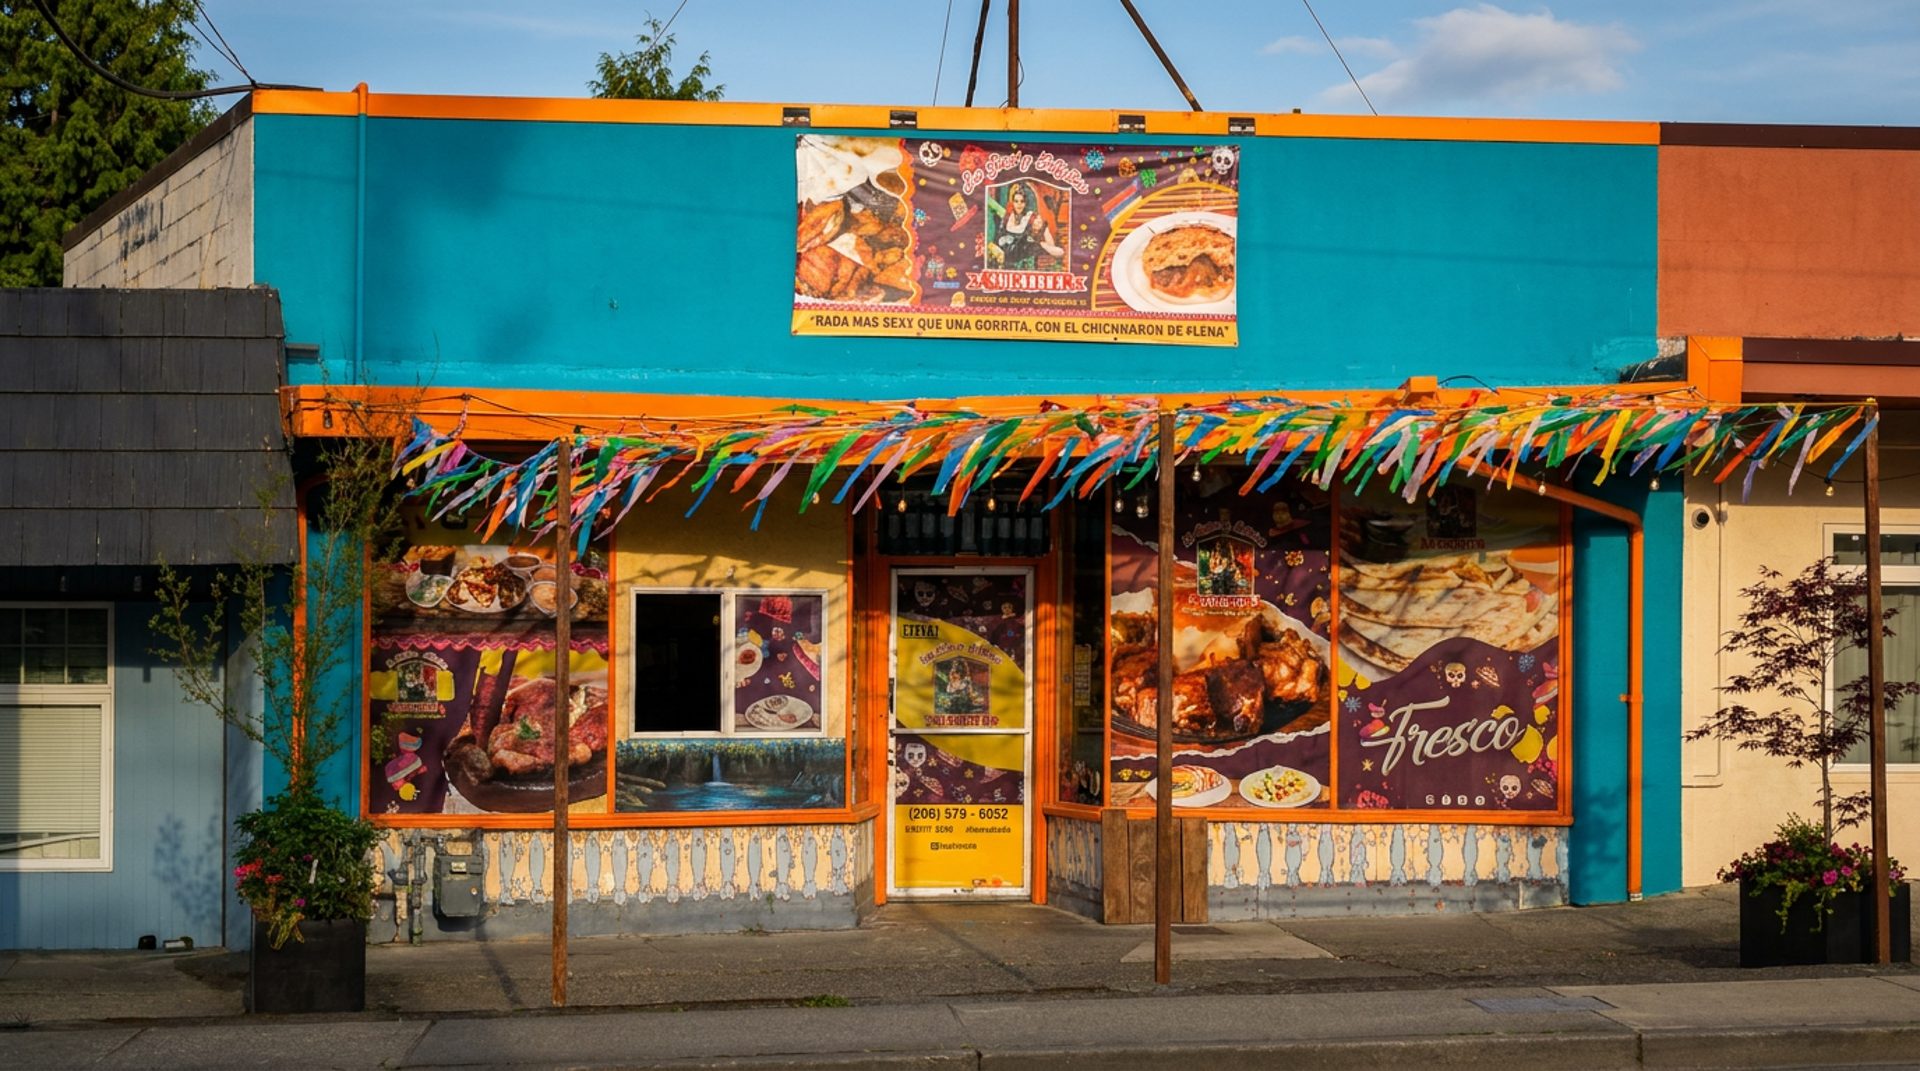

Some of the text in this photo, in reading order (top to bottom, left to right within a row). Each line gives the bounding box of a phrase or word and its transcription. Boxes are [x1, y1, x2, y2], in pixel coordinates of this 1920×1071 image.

[852, 316, 879, 328] MAS
[882, 317, 913, 329] SEXY
[917, 318, 942, 330] QUE
[946, 318, 971, 331] UNA
[975, 319, 1032, 333] GORRITA,
[1035, 320, 1061, 333] CON
[1064, 321, 1078, 334] EL
[1167, 324, 1183, 336] DE
[1360, 695, 1525, 776] Fresco
[909, 808, 940, 821] (206)
[944, 808, 967, 820] 579
[979, 808, 1009, 820] 6052
